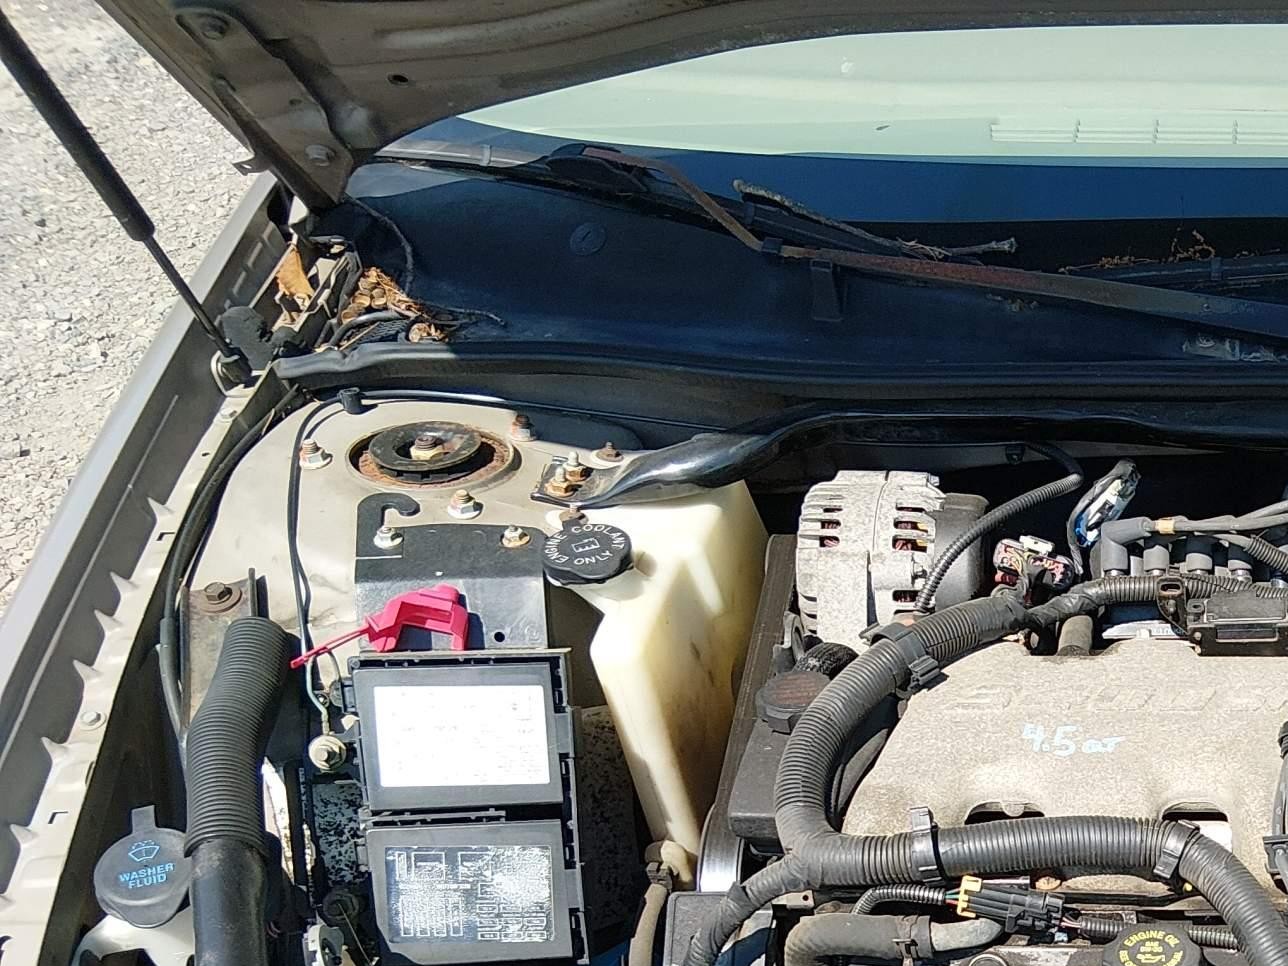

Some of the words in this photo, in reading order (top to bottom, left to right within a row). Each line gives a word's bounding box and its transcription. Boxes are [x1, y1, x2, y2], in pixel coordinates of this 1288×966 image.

[571, 524, 625, 549] COOLANT
[544, 533, 569, 563] ENGINE
[573, 550, 613, 565] ONLY
[118, 862, 174, 882] WASHER
[128, 873, 167, 889] FLUID
[1123, 930, 1166, 946] ENGINE
[1164, 934, 1180, 948] OIL
